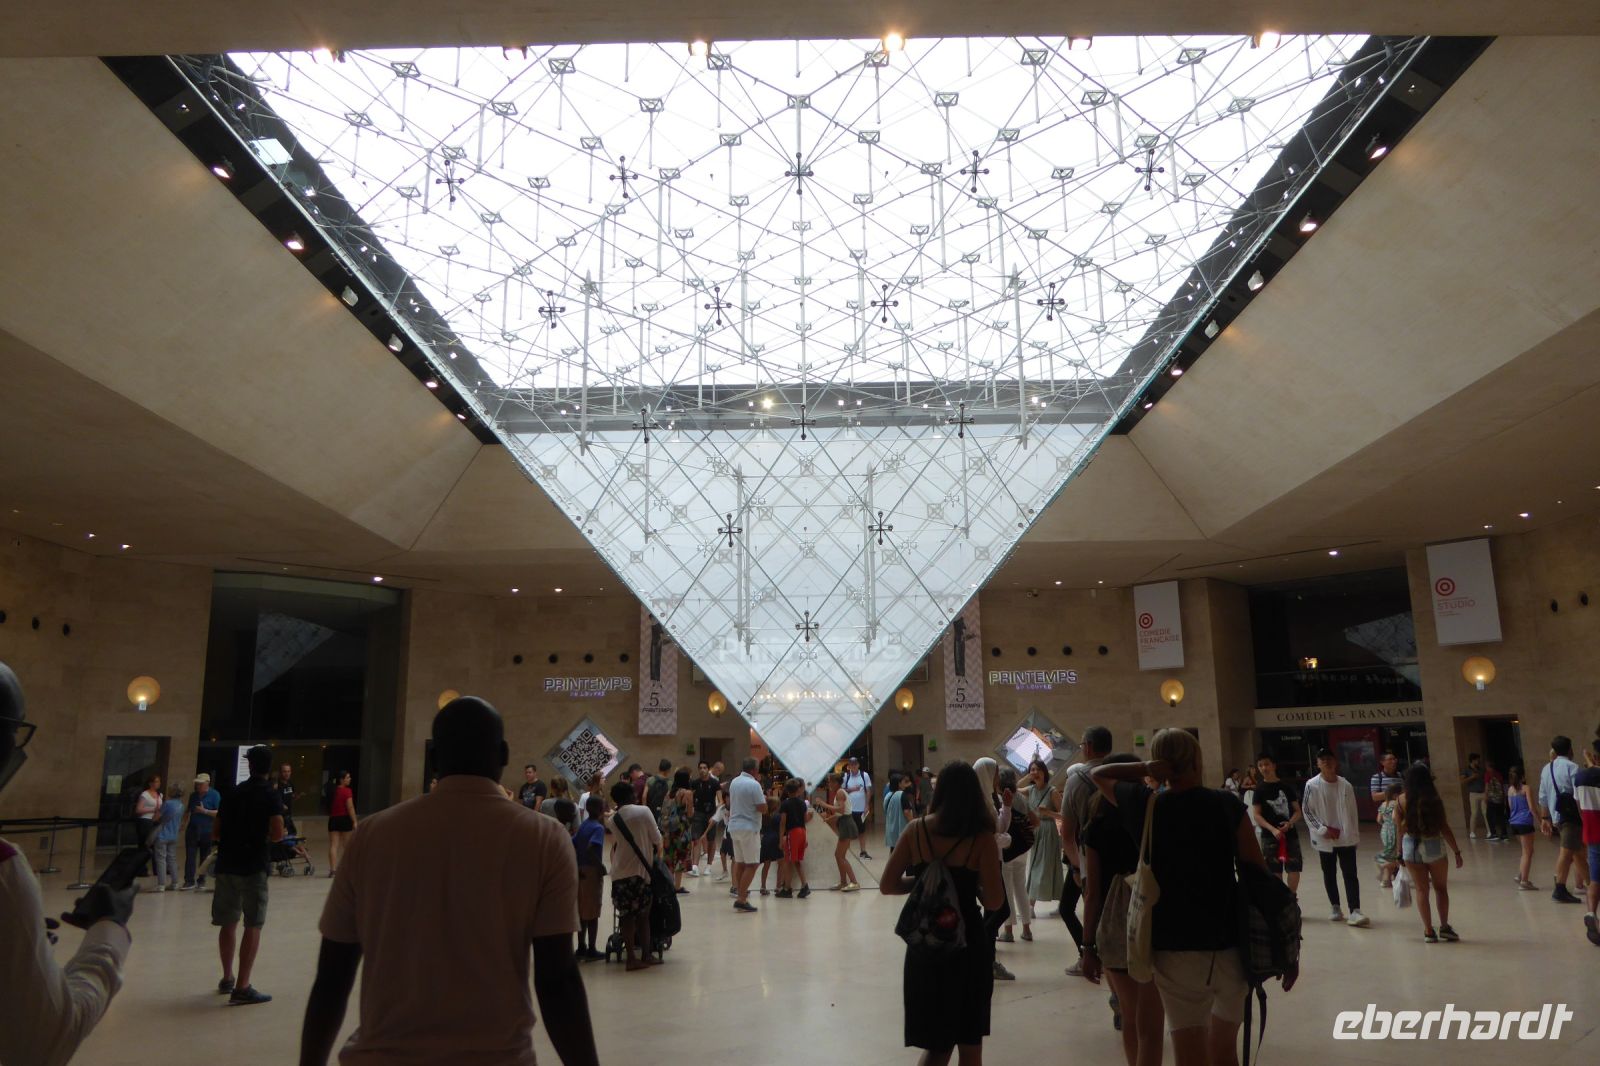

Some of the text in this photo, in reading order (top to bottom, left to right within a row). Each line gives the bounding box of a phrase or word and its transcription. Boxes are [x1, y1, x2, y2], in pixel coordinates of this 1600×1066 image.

[1437, 599, 1476, 610] STUDIO
[544, 677, 632, 692] PRINTEMPS
[988, 670, 1078, 686] PRINTEMPS
[649, 692, 659, 707] 5
[956, 687, 966, 703] 5
